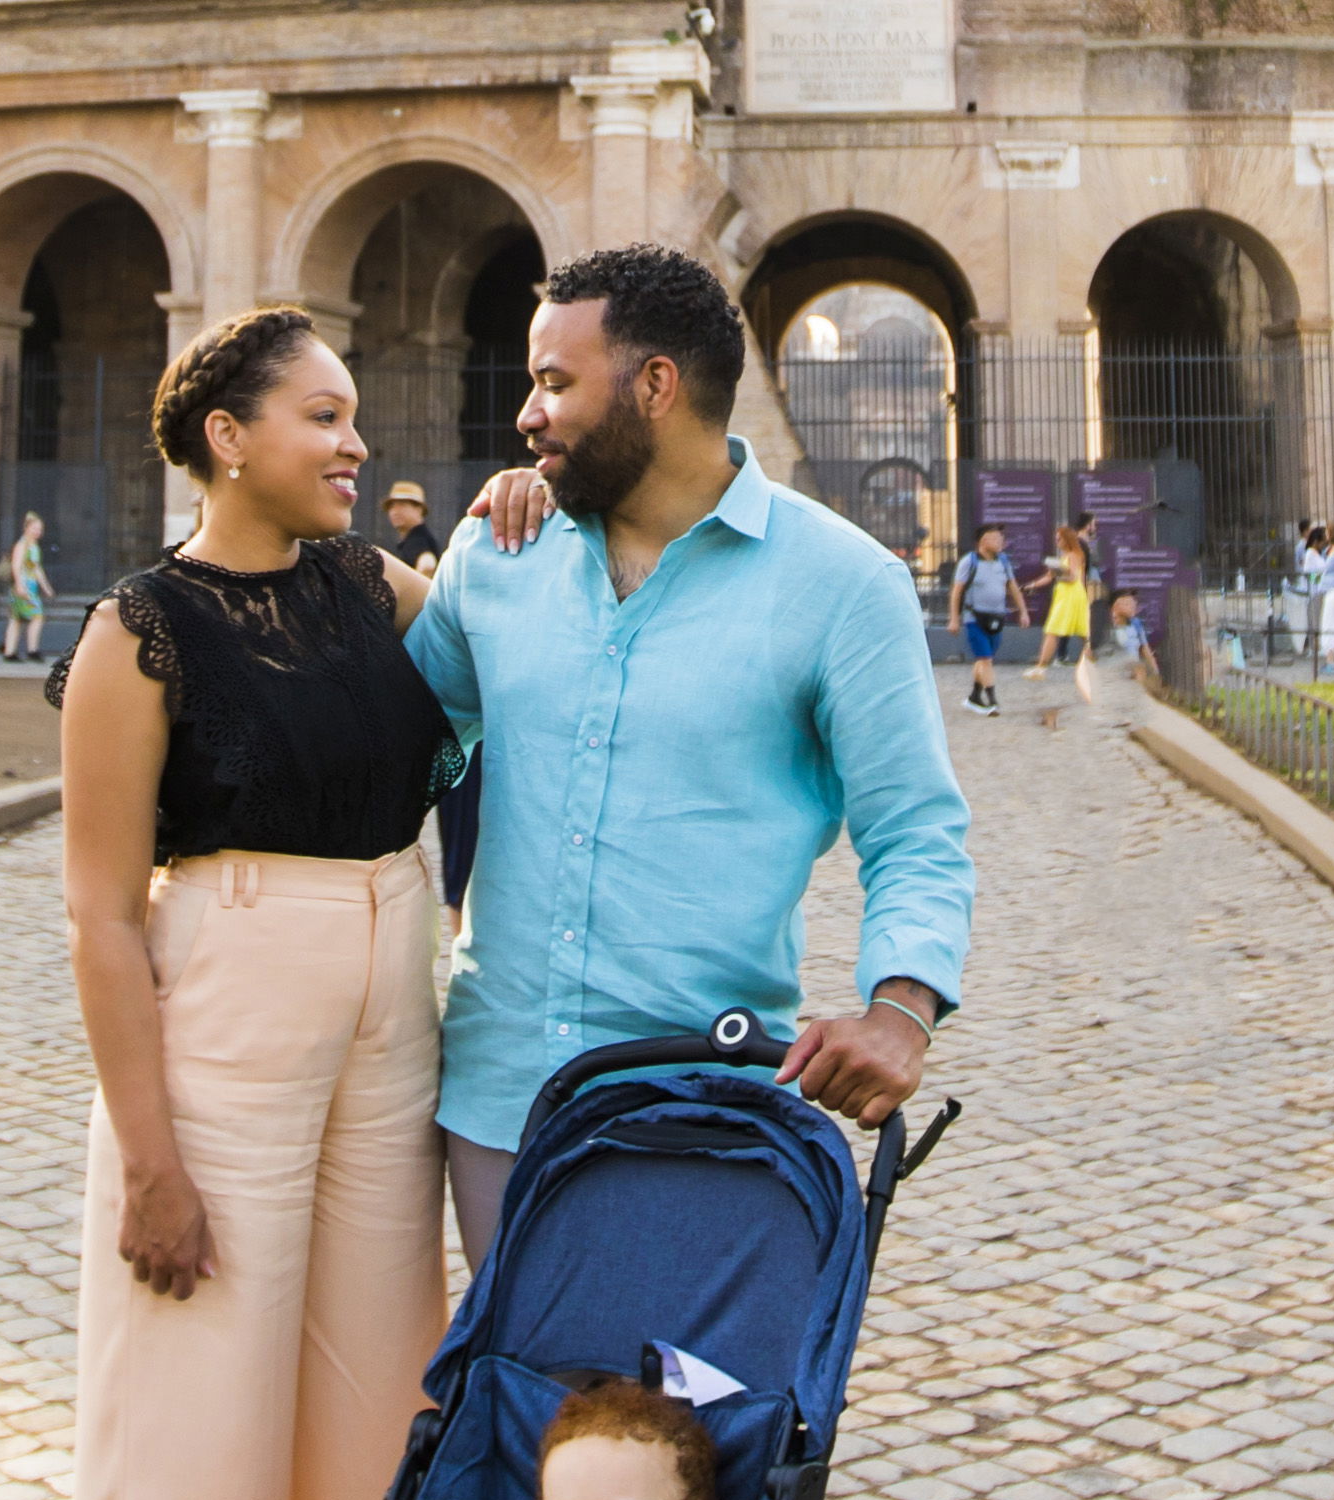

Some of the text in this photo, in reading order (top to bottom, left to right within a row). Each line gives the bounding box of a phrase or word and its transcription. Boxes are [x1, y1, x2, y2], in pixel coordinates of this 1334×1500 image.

[812, 32, 829, 46] IX
[835, 32, 876, 47] PONT
[885, 30, 929, 47] MAX
